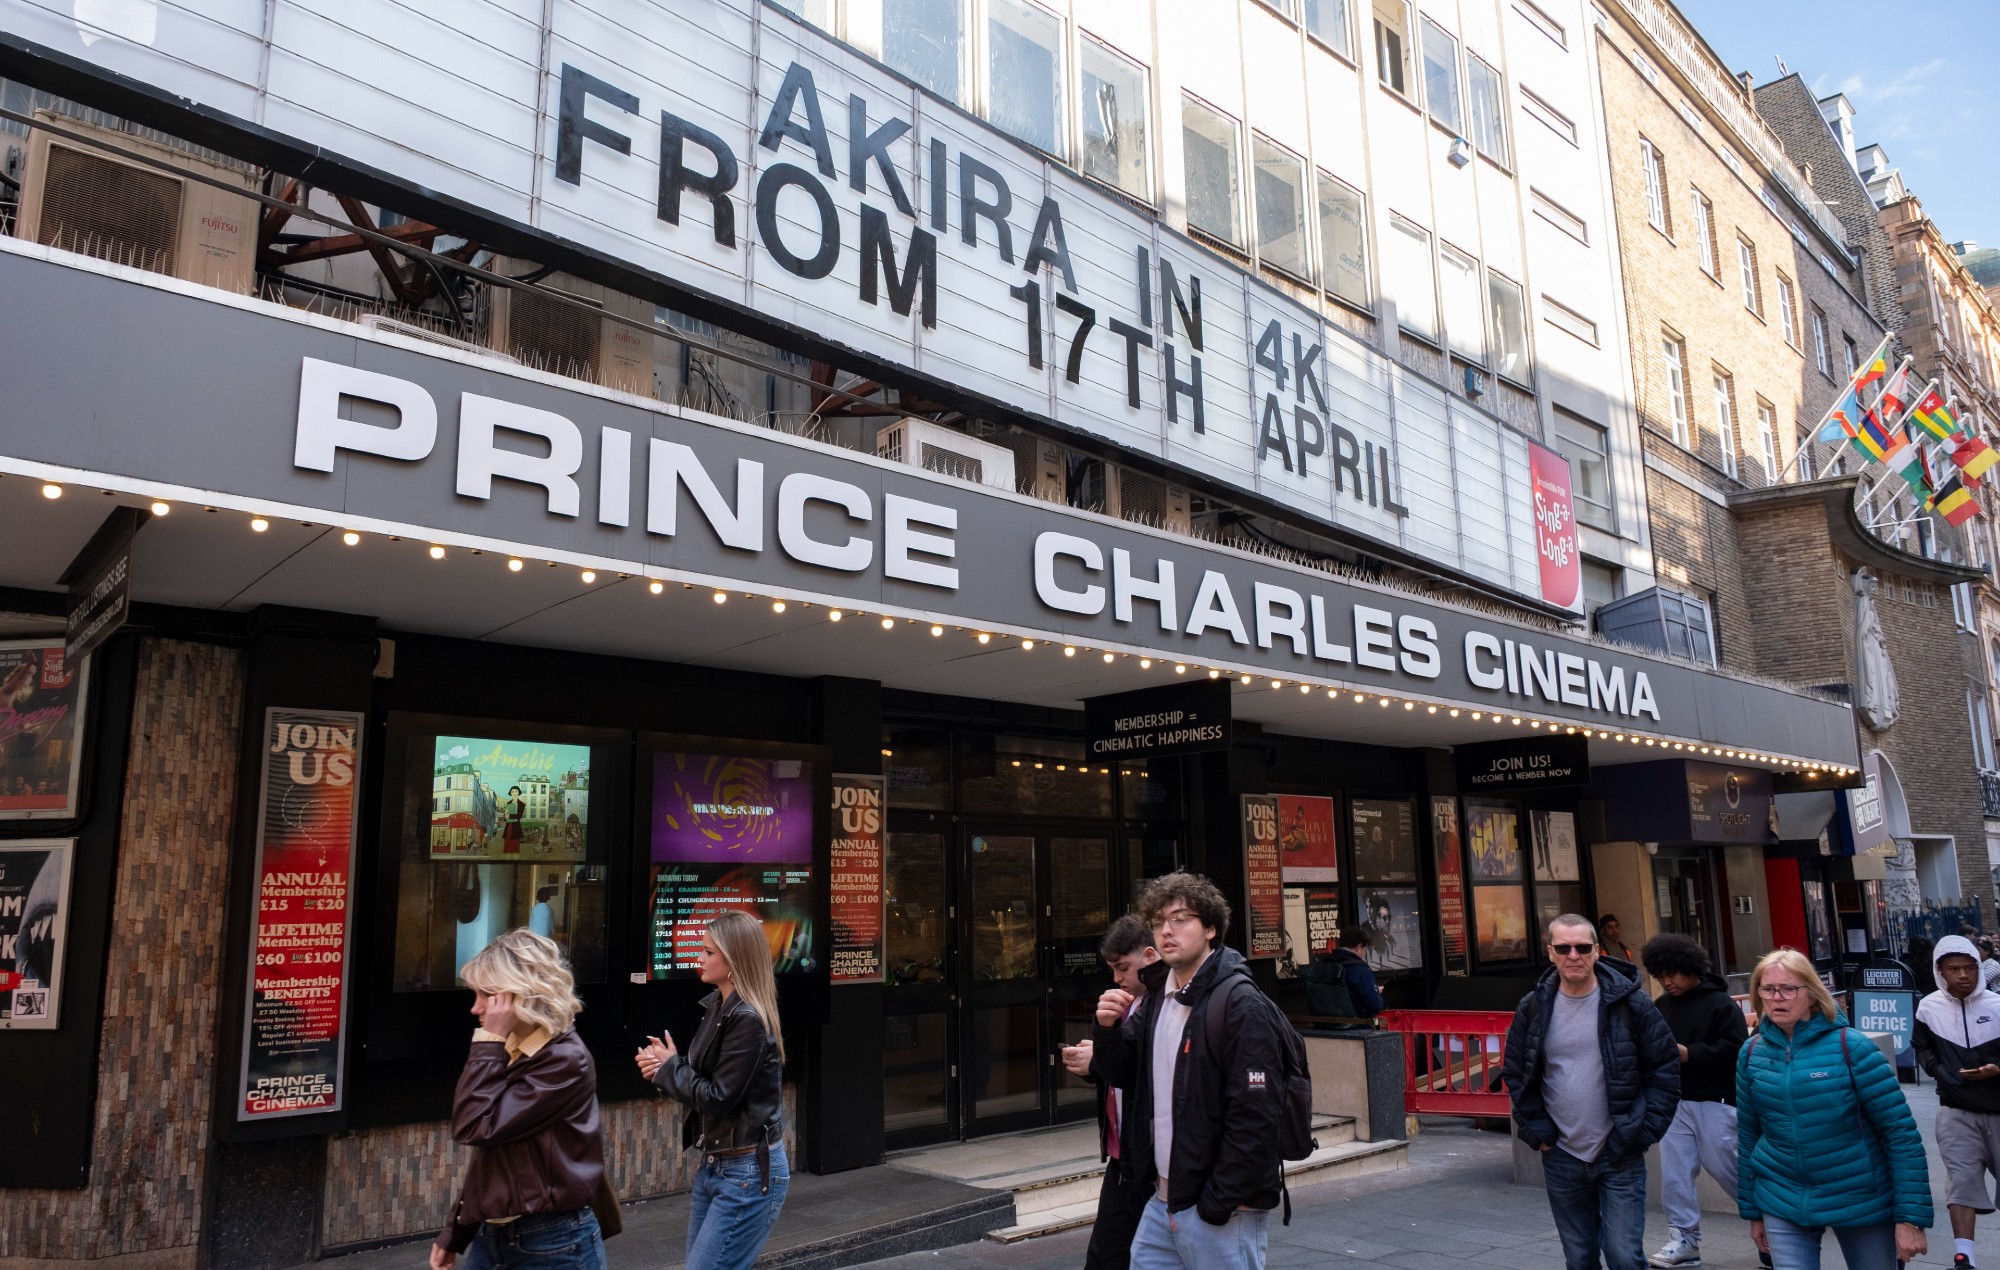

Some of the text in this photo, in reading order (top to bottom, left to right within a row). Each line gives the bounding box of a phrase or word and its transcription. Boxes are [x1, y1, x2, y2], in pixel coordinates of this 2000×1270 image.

[202, 216, 237, 233] FUJITSU
[759, 60, 1330, 415] AKIRA IN 4K
[555, 62, 1409, 519] FROM 17TH APRIL
[294, 356, 1660, 721] PRINCE CHARLES CINEMA
[115, 556, 128, 585] SEE
[1114, 710, 1184, 732] MEMBERSHIP
[271, 723, 355, 752] JOIN
[1093, 725, 1222, 752] CINEMATIC HAPPINESS
[287, 751, 353, 786] US
[1489, 754, 1551, 771] JOIN US!
[1471, 773, 1505, 783] BECOME
[1516, 771, 1546, 780] MEMBER
[1549, 768, 1571, 777] NOW
[831, 786, 880, 809] JOIN
[1246, 804, 1275, 821] JOIN
[1353, 808, 1382, 817] Sentimental
[1433, 802, 1454, 817] JOIN
[841, 807, 880, 833] US
[1438, 815, 1455, 832] US
[1719, 812, 1751, 824] SPOTLIGHT
[1252, 820, 1277, 840] US
[831, 839, 878, 849] ANNUAL
[831, 849, 878, 859] Membership
[1248, 852, 1277, 860] Membership
[831, 859, 878, 867] £15 £20
[262, 873, 346, 886] ANNUAL
[656, 874, 699, 882] SHOWING TODAY
[831, 874, 879, 883] LIFETIME
[261, 886, 345, 898] Membership
[831, 883, 879, 892] Membership
[260, 900, 288, 911] £15
[317, 899, 344, 910] £20
[831, 895, 879, 904] £60 £100
[1309, 910, 1338, 921] ONE FLEW
[259, 923, 343, 936] LIFETIME
[1310, 920, 1336, 930] OVER THE
[258, 935, 342, 948] Membership
[1252, 937, 1281, 945] CHARLES
[1311, 940, 1327, 949] NEST
[256, 953, 285, 965] £60
[304, 952, 341, 963] £100
[834, 951, 873, 959] PRINCE
[830, 959, 878, 968] CHARLES
[833, 967, 875, 975] CINEMA
[255, 975, 340, 989] Membership
[264, 987, 330, 1000] BENEFITS
[1870, 999, 1897, 1013] BOX
[1861, 1016, 1907, 1031] OFFICE
[257, 1074, 326, 1089] PRINCE
[246, 1084, 334, 1101] CHARLES
[253, 1095, 326, 1110] CINEMA
